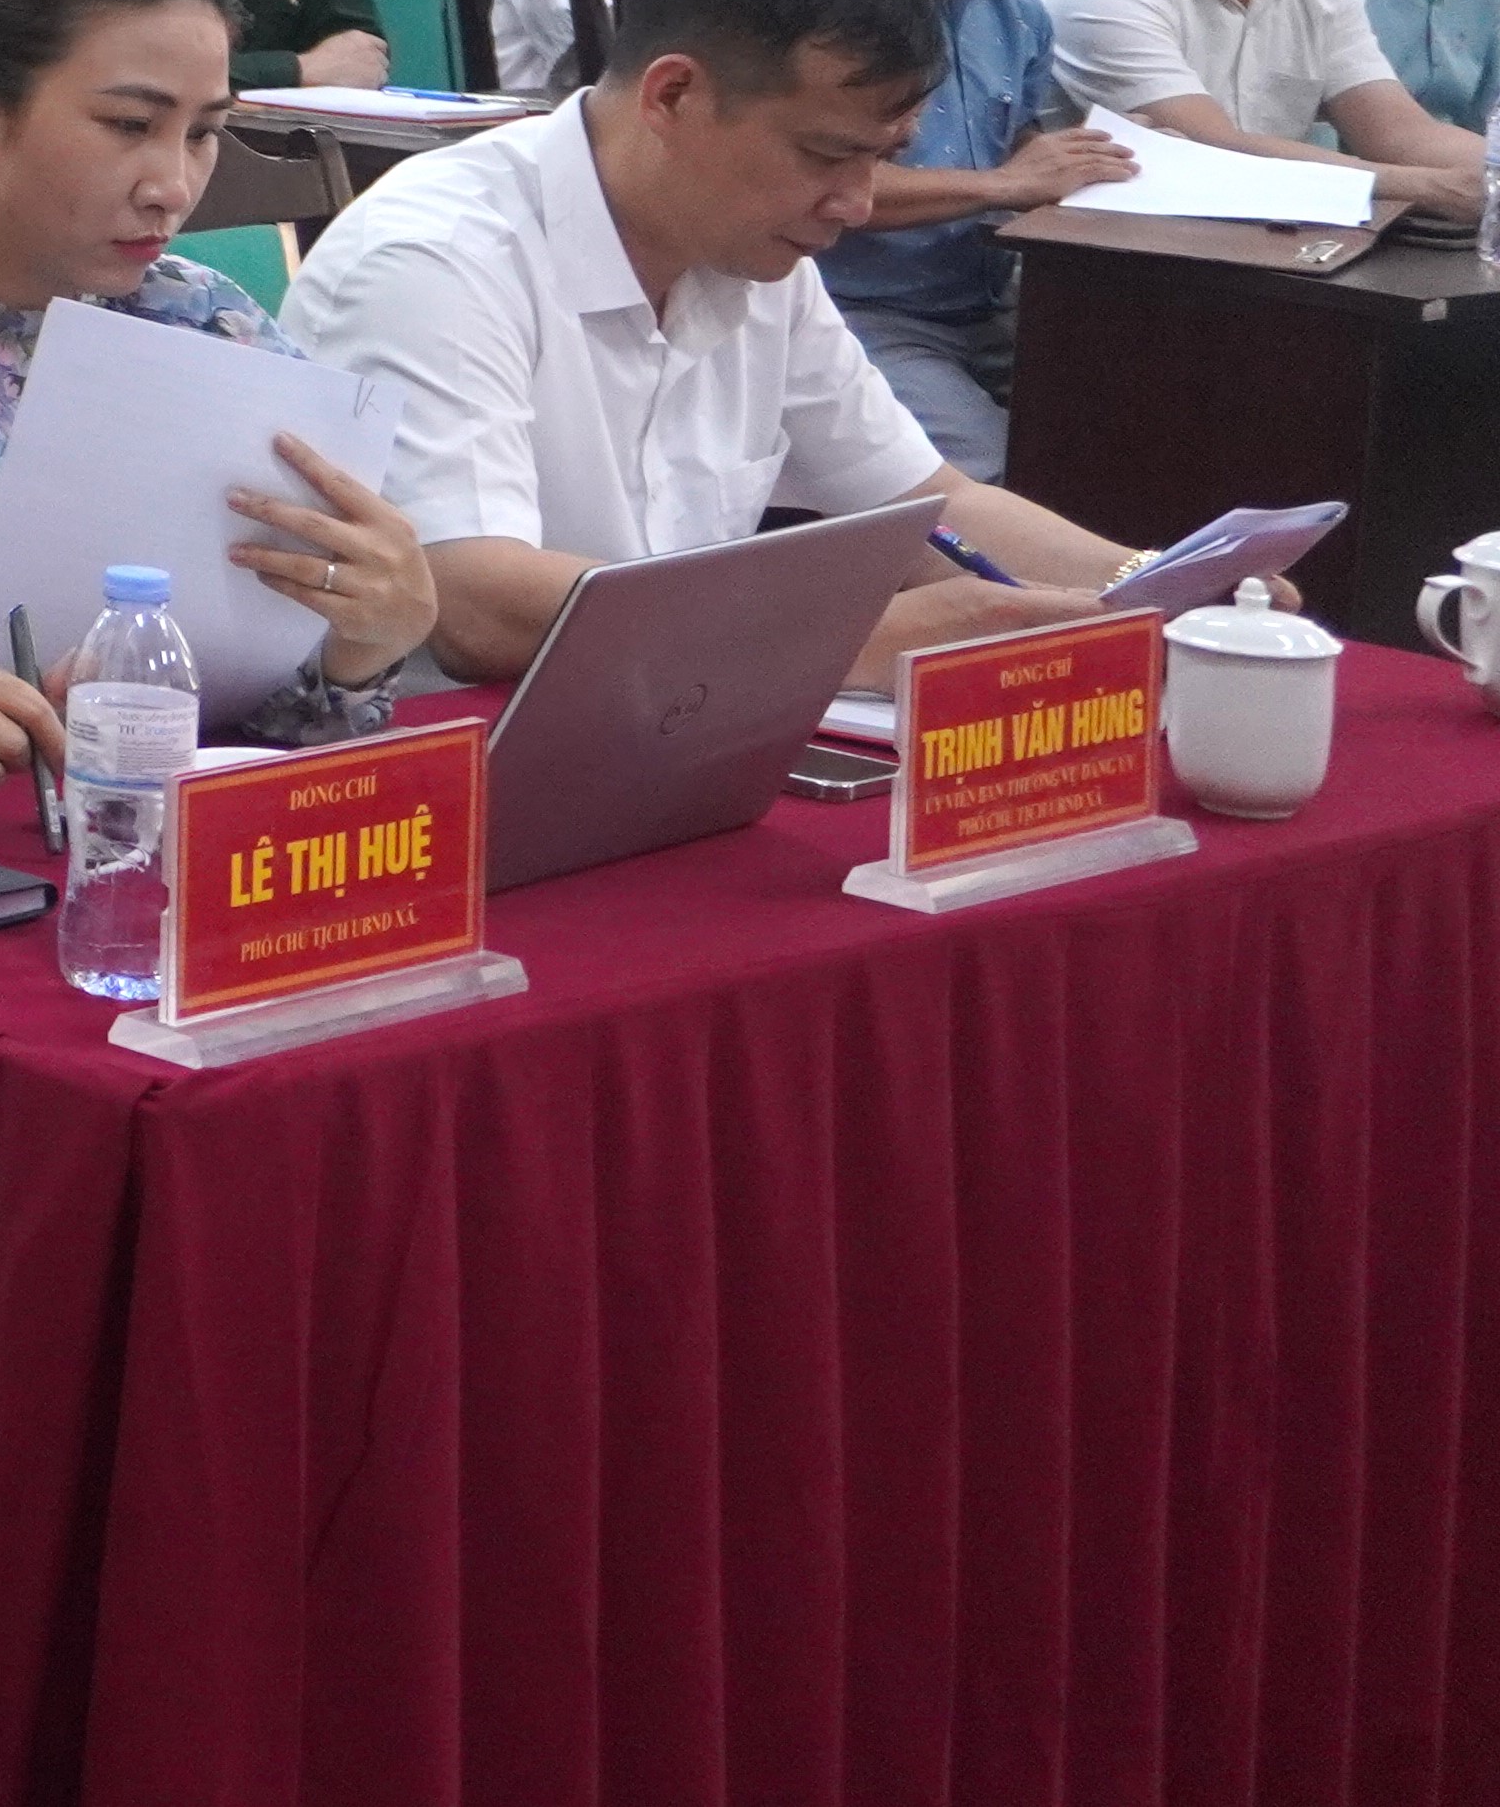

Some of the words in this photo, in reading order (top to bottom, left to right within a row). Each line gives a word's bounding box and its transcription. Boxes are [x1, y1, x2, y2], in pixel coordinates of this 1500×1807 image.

[921, 717, 1003, 785] TRỊNH
[1011, 699, 1065, 761] VĂN
[1072, 687, 1144, 747] HÙNG
[289, 780, 342, 811] ĐỒNG
[345, 767, 379, 800] CHÍ
[230, 835, 274, 908] LÊ
[286, 831, 347, 898] THỊ
[358, 803, 433, 881] HUỆ
[240, 933, 272, 963] PHÓ
[313, 921, 349, 951] TỊCH
[351, 911, 392, 937] UBND
